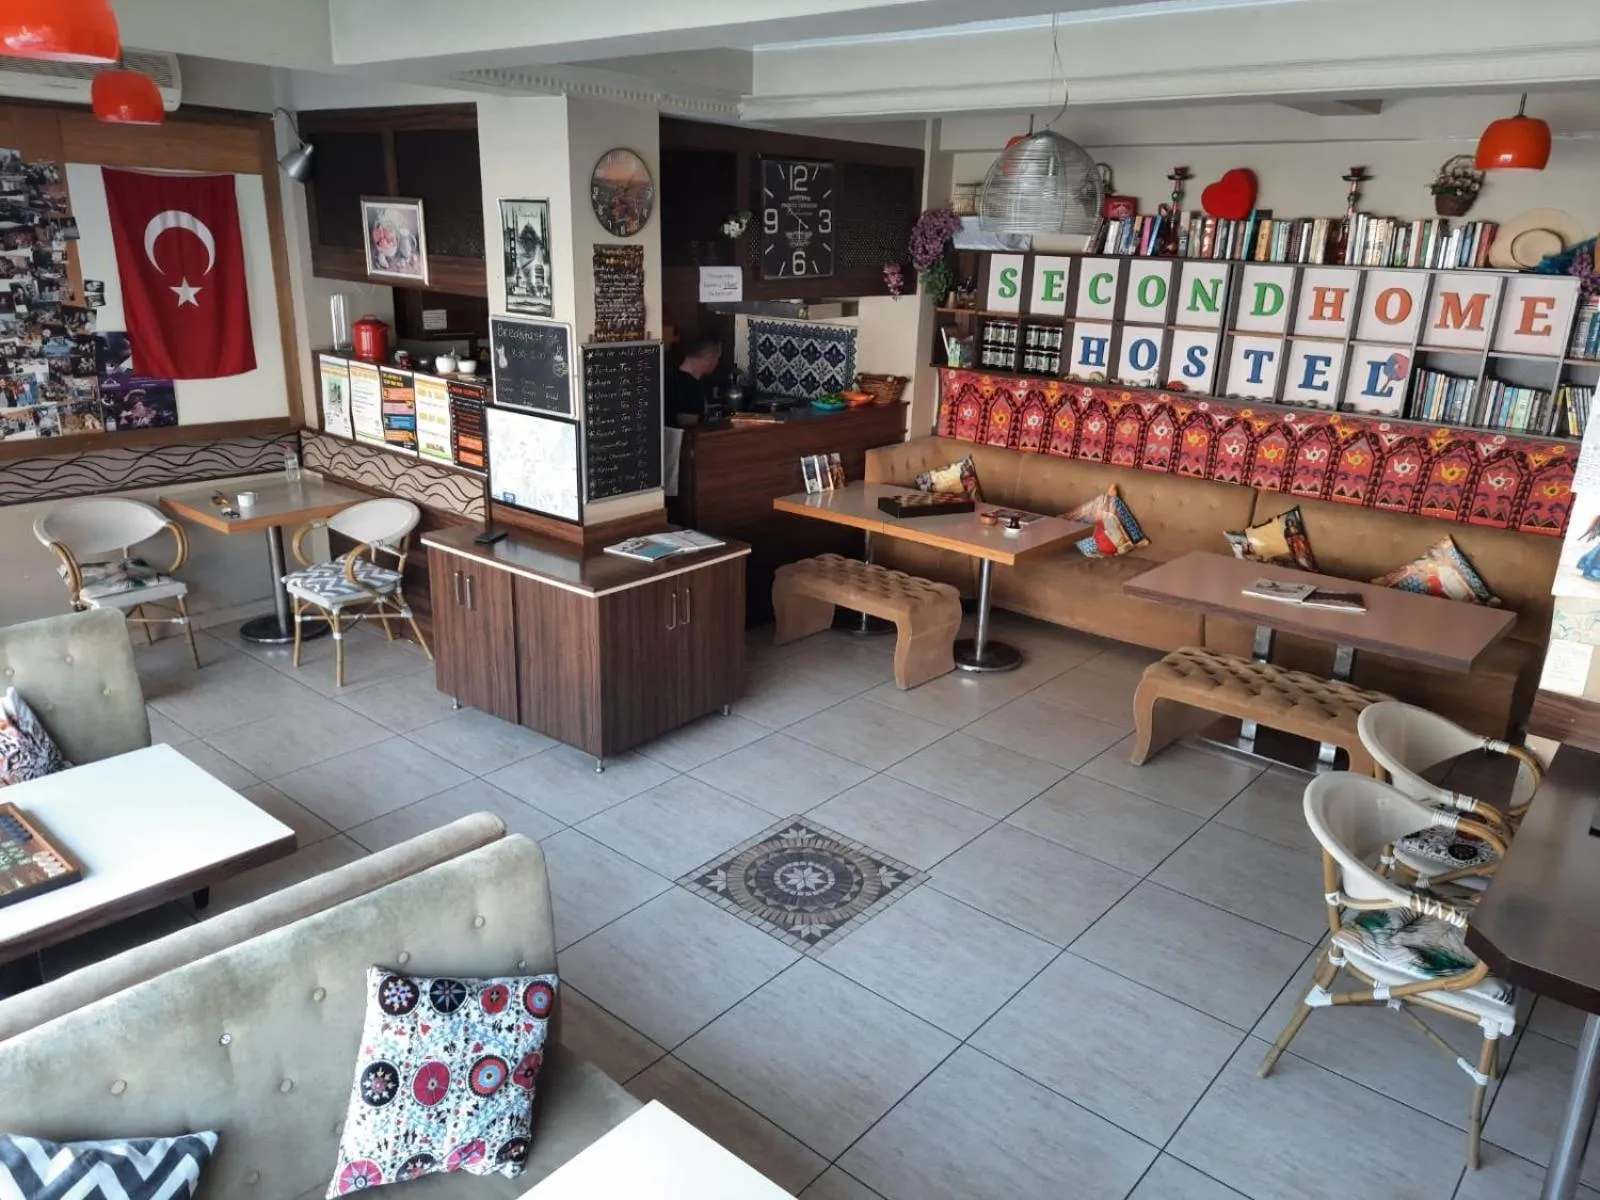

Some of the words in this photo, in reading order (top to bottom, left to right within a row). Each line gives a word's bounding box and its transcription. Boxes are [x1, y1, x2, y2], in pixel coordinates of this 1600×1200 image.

[789, 164, 809, 192] 12
[764, 208, 779, 235] 9
[818, 208, 832, 234] 3
[792, 250, 806, 276] 6
[999, 267, 1285, 317] SECOND
[1308, 286, 1556, 337] HOME
[1077, 335, 1395, 398] HOSTEL
